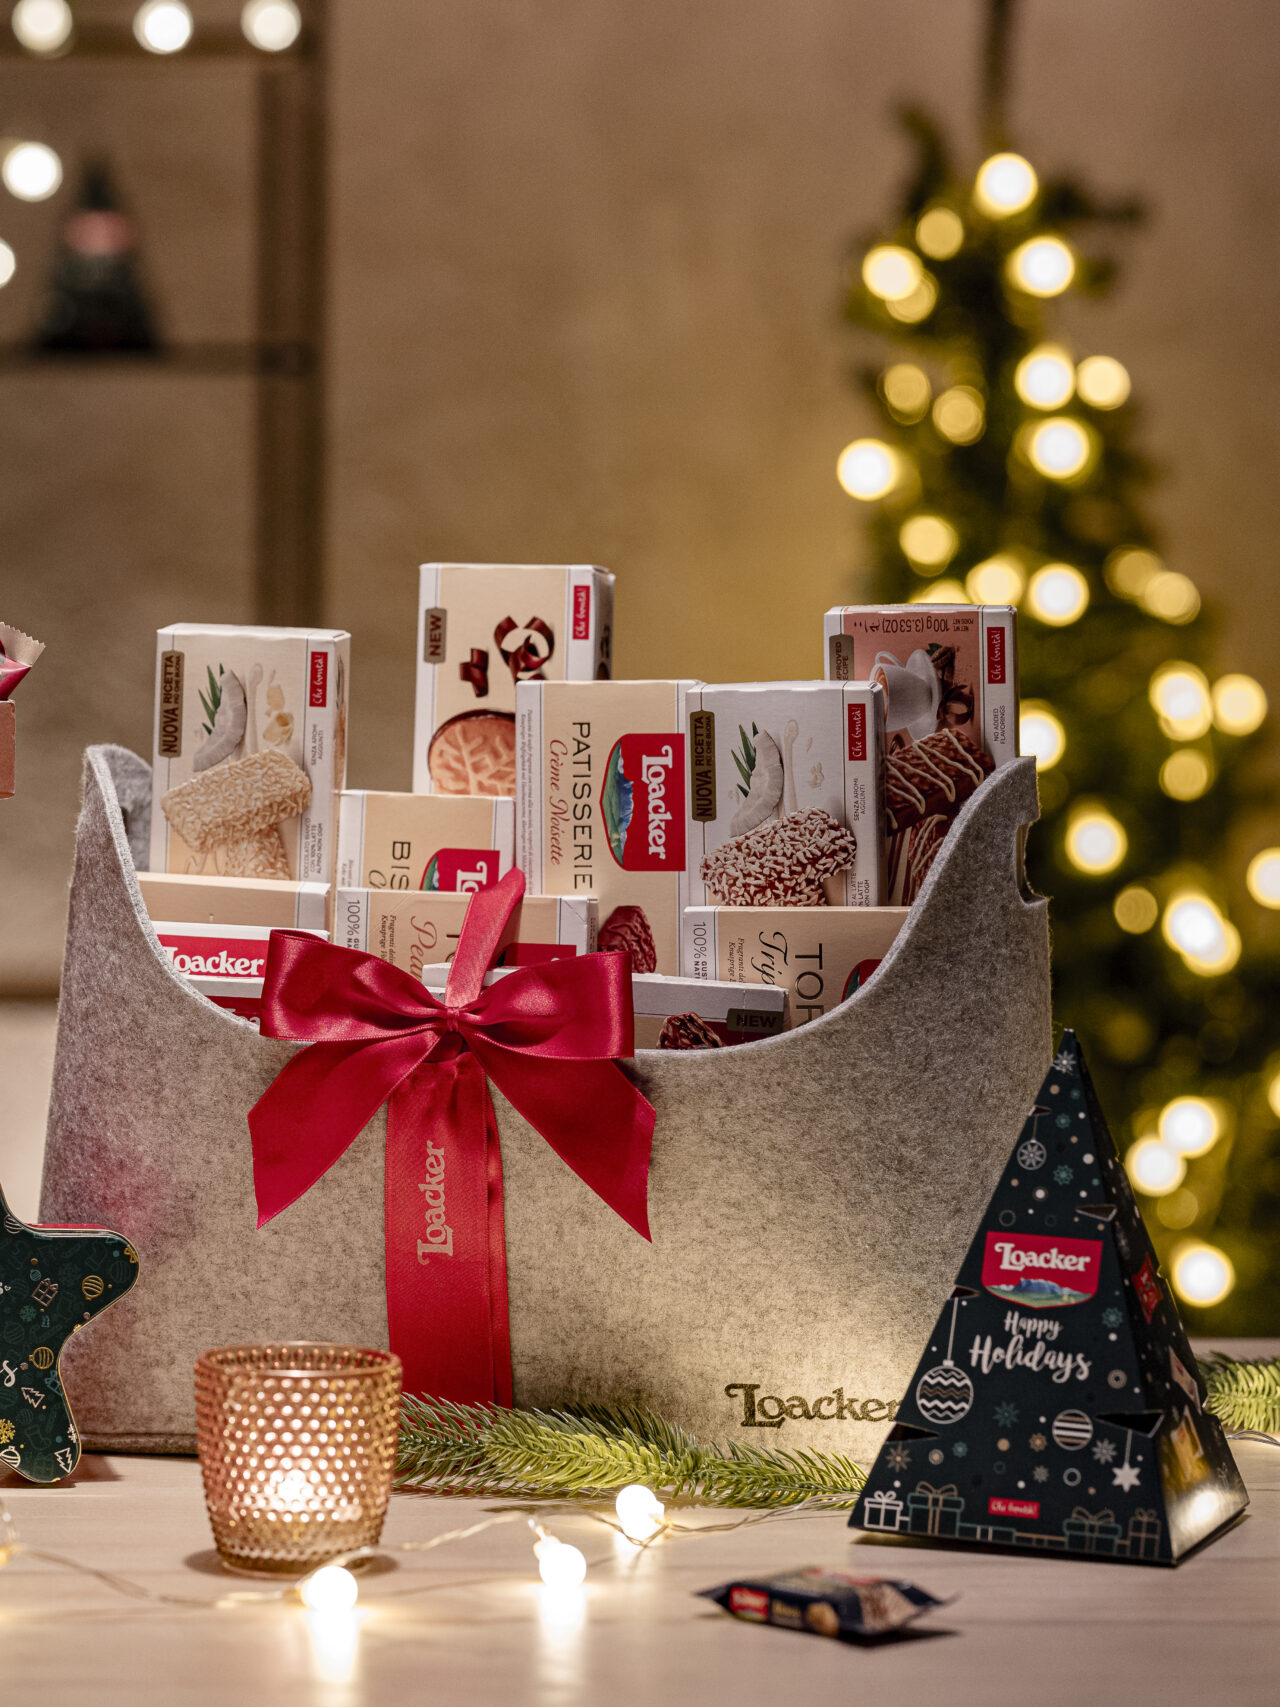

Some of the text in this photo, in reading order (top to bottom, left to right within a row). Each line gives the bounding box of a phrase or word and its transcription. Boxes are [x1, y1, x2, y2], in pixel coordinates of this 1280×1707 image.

[429, 614, 442, 656] NEW
[990, 662, 1002, 681] Che
[162, 655, 179, 753] NUOVA RICETTA
[851, 741, 862, 758] Che
[994, 731, 999, 742] NO
[694, 716, 713, 817] NUOVA RICETTA
[549, 739, 570, 865] Crème Noisette
[572, 722, 592, 889] PATISSERIE
[641, 744, 673, 860] Loacker
[346, 899, 360, 936] 100%
[693, 922, 707, 959] 100%
[736, 1014, 777, 1028] NEW
[417, 1140, 453, 1266] Loacker
[994, 1242, 1091, 1272] Loacker
[1004, 1310, 1064, 1341] Happy
[969, 1334, 1092, 1384] Holidays
[724, 1383, 901, 1428] Loacker
